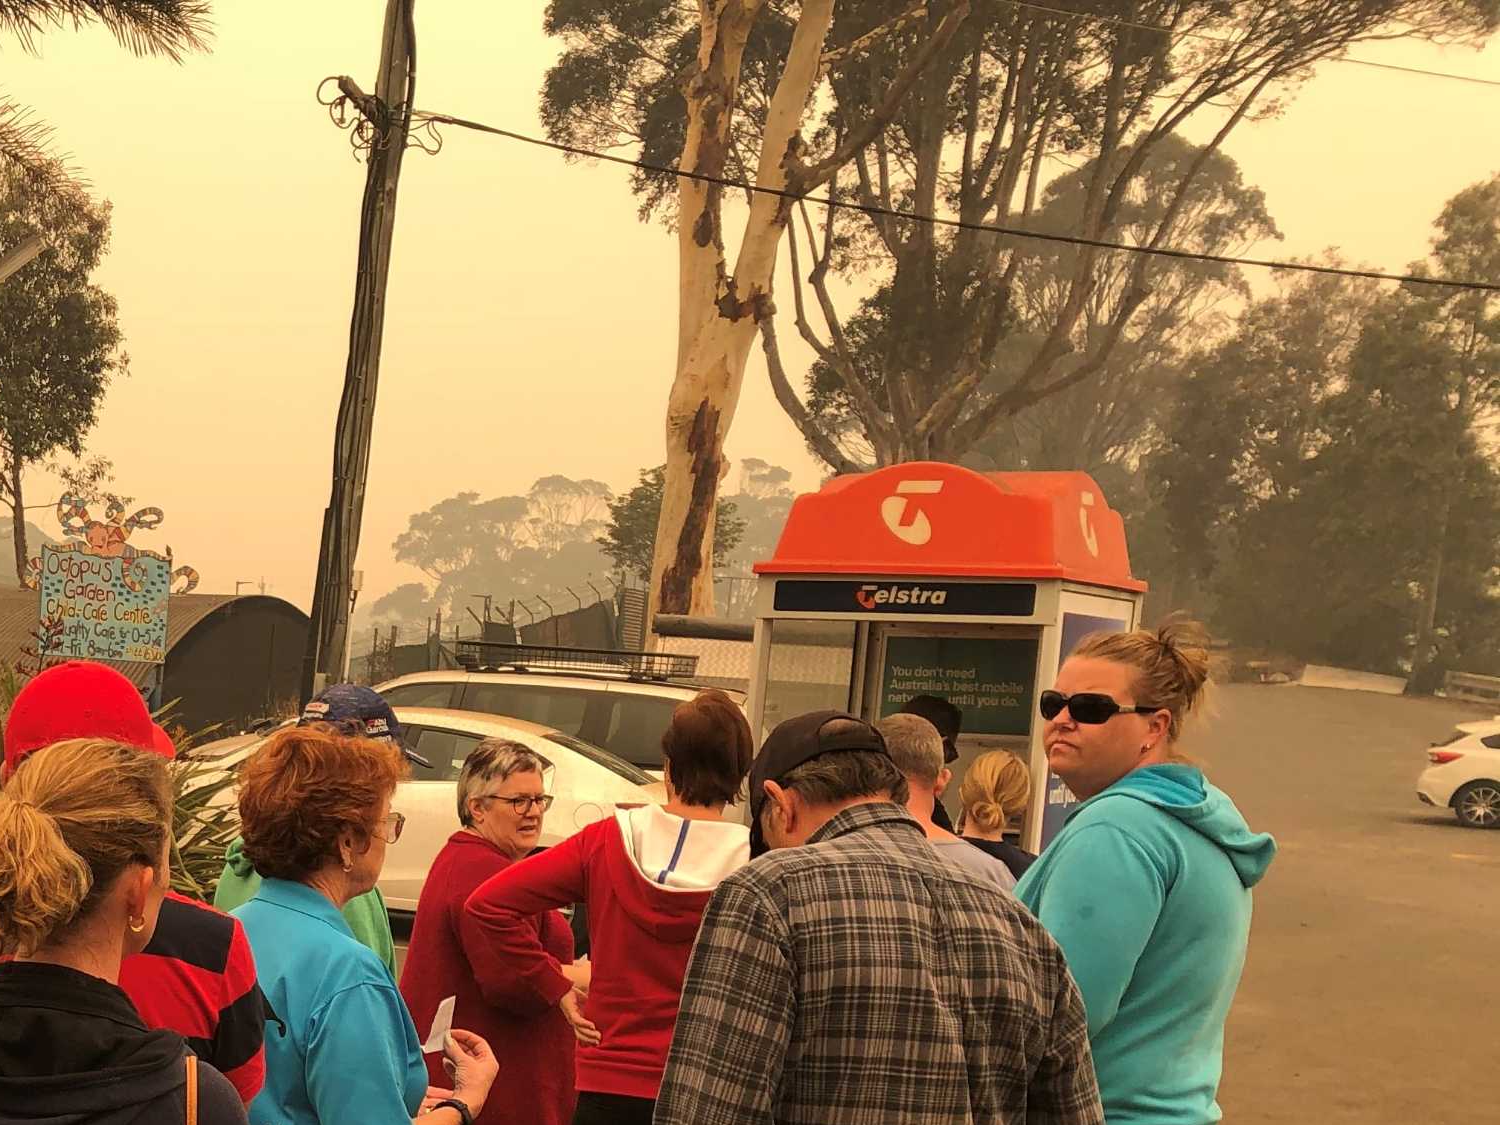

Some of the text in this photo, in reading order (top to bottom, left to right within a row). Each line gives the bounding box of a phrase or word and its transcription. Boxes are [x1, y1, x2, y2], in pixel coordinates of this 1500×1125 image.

[64, 579, 116, 602] Garden
[856, 585, 947, 609] Telstra
[114, 602, 152, 624] Centre
[63, 621, 90, 642] uality
[94, 622, 116, 640] Care
[891, 665, 976, 679] You don't need
[890, 680, 1024, 694] Australia's best mobile
[948, 693, 975, 705] until
[977, 697, 1000, 709] you
[1000, 697, 1019, 707] do.
